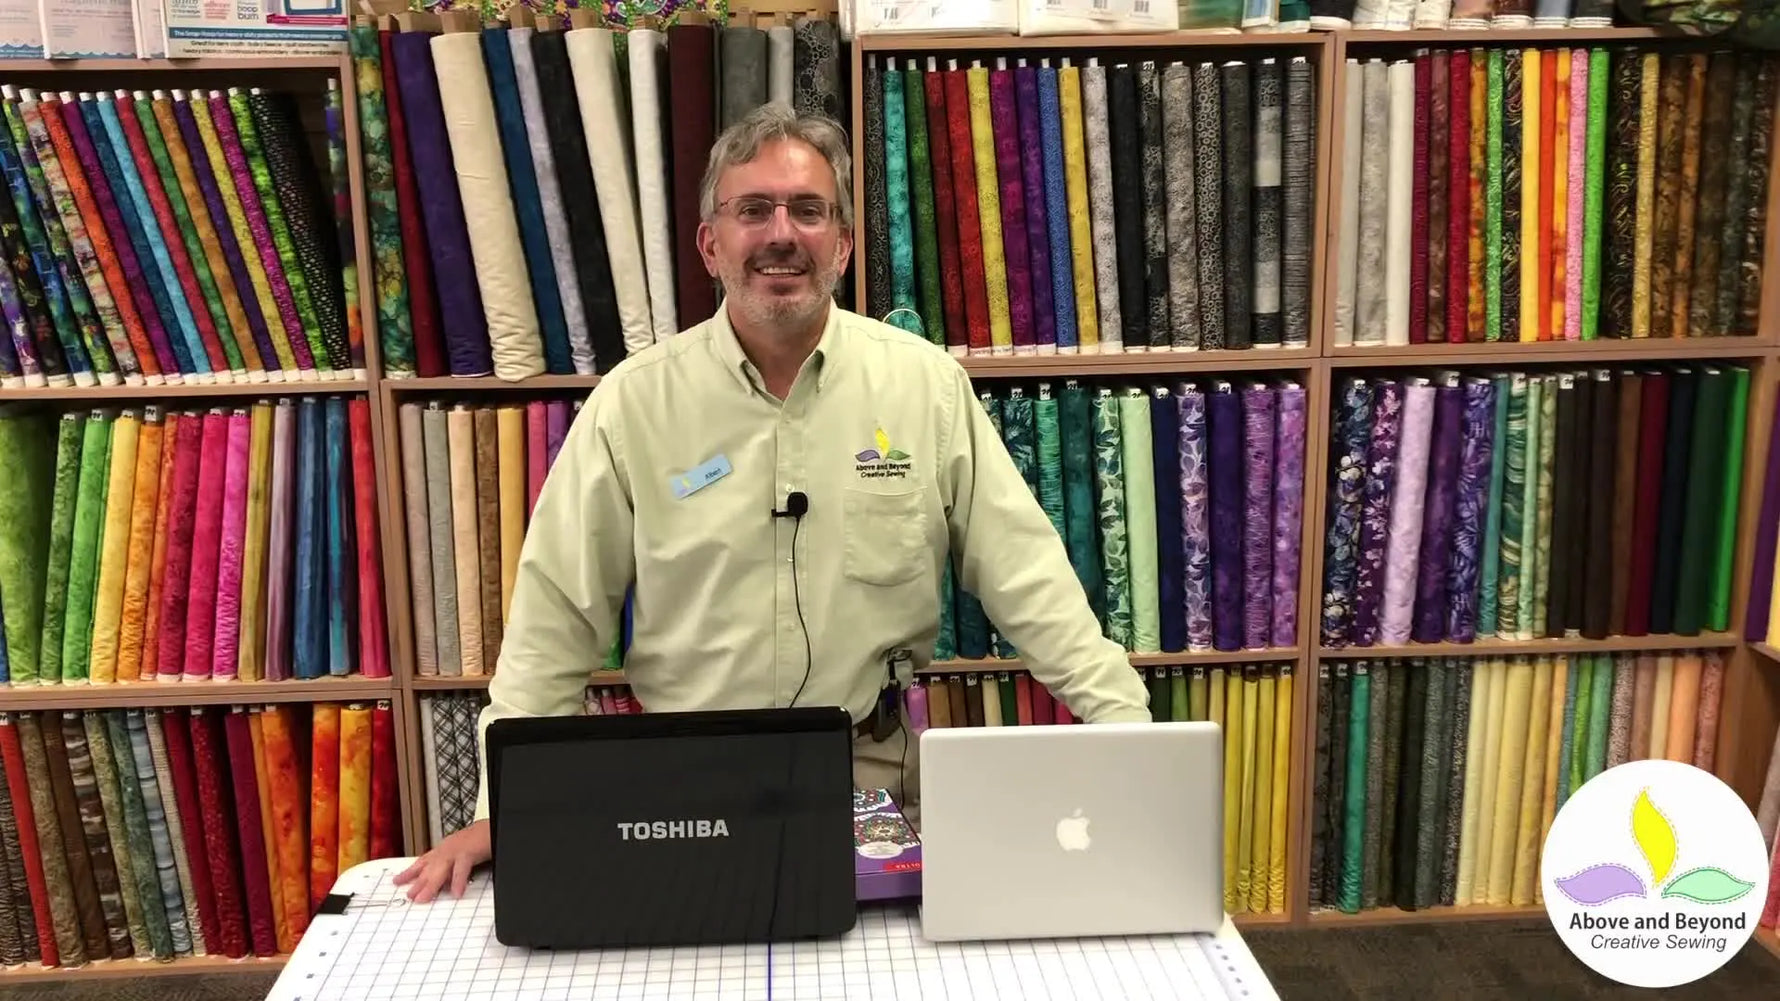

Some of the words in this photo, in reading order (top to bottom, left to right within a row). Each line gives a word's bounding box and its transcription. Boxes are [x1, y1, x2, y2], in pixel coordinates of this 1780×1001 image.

[889, 463, 911, 471] Beyond
[886, 470, 906, 478] Sewing
[617, 819, 730, 840] TOSHIBA
